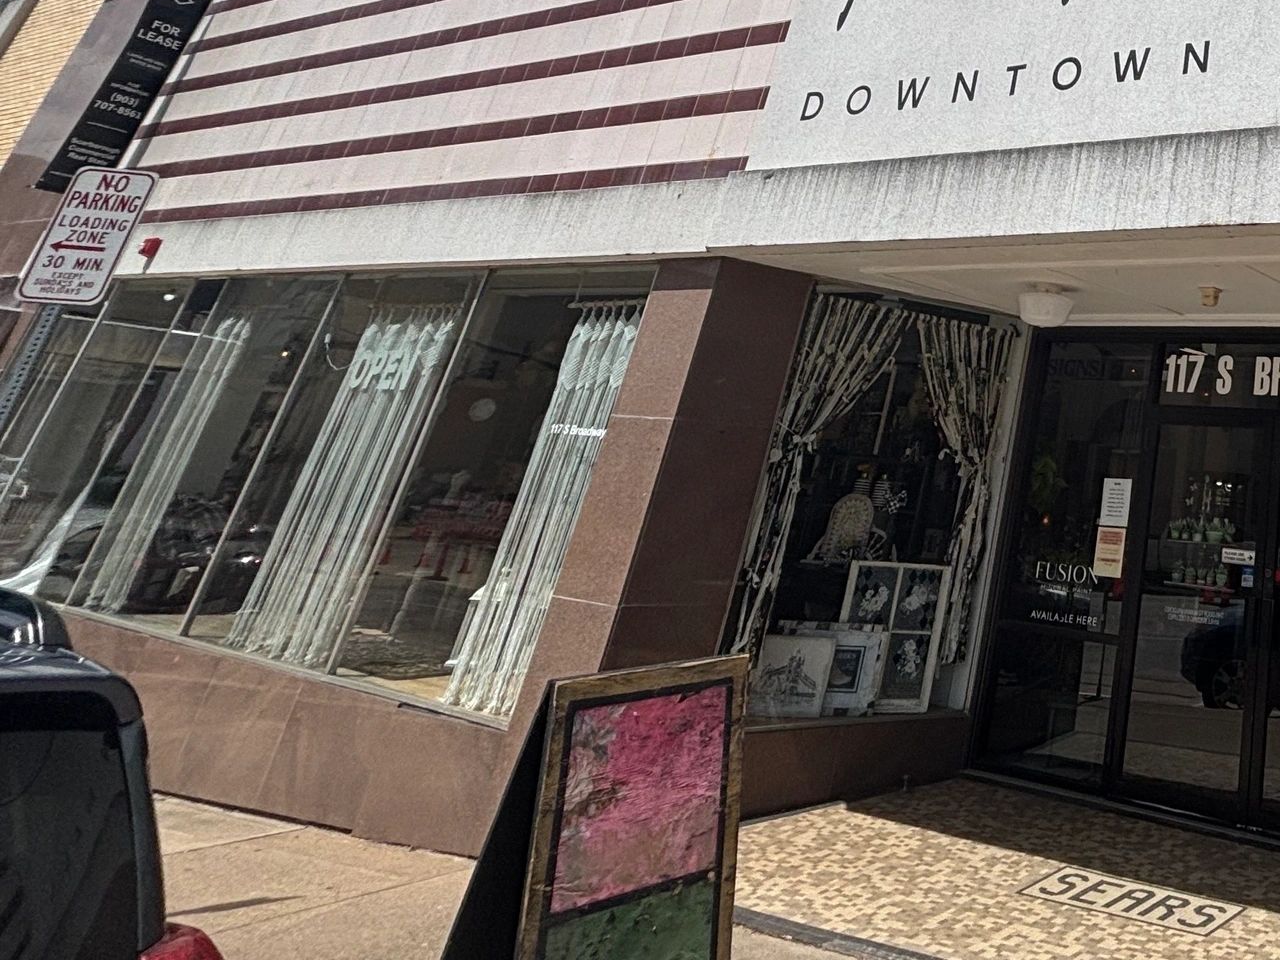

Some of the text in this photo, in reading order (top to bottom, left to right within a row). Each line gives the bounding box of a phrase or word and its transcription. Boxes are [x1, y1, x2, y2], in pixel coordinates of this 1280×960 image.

[151, 19, 181, 37] FOR
[137, 28, 183, 51] LEASE
[799, 40, 1212, 123] DOWNTOWN
[110, 92, 140, 108] (903)
[93, 99, 143, 120] 707-8561
[96, 174, 131, 193] NO
[66, 191, 142, 213] PARKING
[58, 215, 130, 232] LOADING
[65, 229, 111, 245] ZONE
[42, 255, 104, 271] 30 MIN.
[51, 272, 85, 280] EXCEPT
[75, 281, 95, 289] AND
[349, 349, 419, 390] OPEN
[1165, 354, 1205, 393] 117
[1215, 354, 1234, 395] S
[551, 423, 608, 440] 117 S Broadway
[1035, 561, 1098, 585] FUSION
[1076, 615, 1099, 627] HERE
[1038, 873, 1228, 929] SEARS
